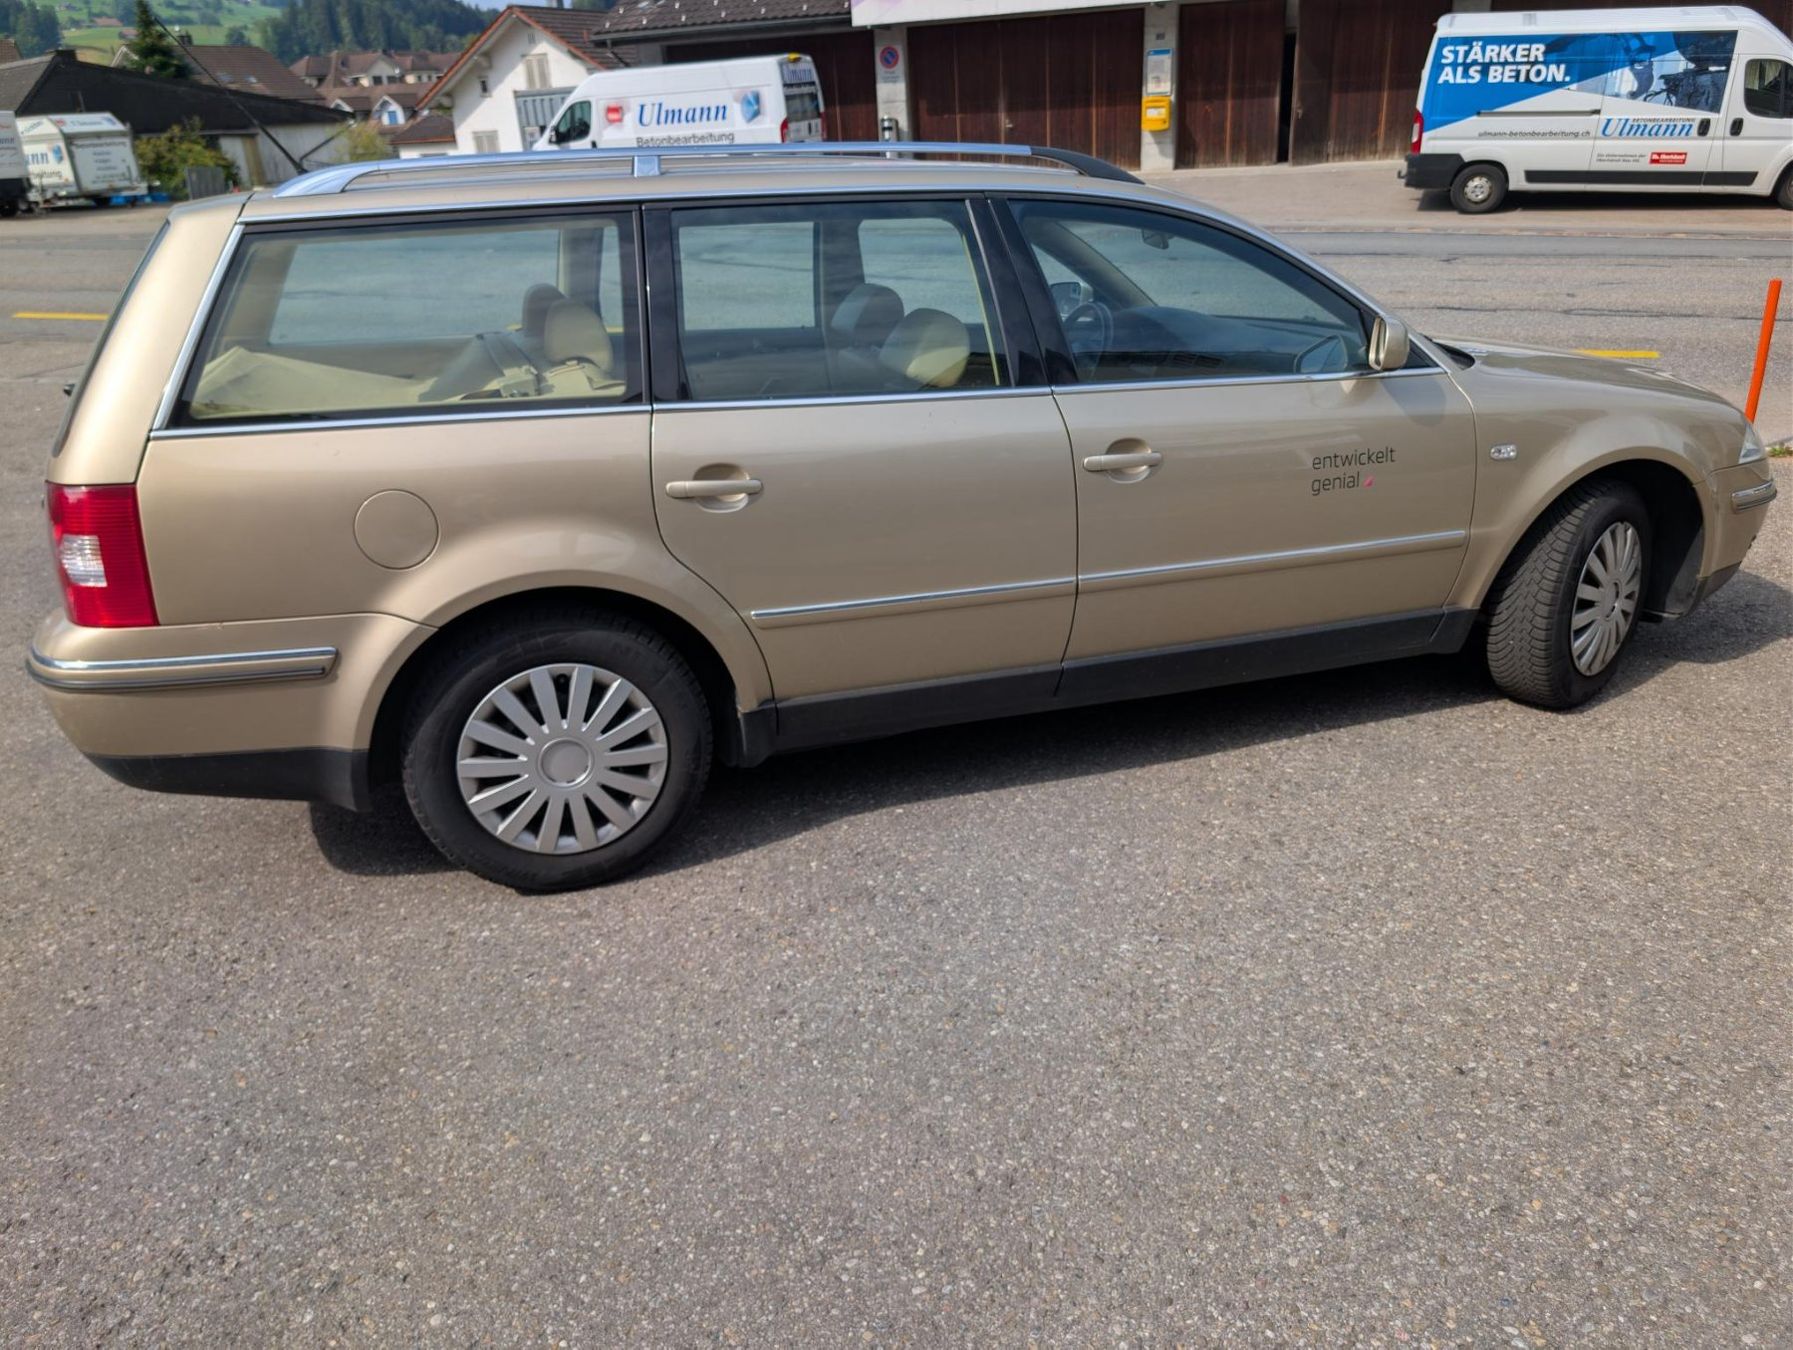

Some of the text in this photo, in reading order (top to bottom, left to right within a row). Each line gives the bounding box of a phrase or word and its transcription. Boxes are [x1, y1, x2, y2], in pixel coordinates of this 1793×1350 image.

[1441, 41, 1546, 64] STÄRKER
[1437, 64, 1571, 84] ALS BETON.
[639, 102, 727, 127] Ulmann
[1478, 129, 1591, 138] ulmann-betonbearbeitung.ch
[1601, 117, 1693, 137] Ulmann
[636, 132, 735, 145] Betonbearbeitung
[1312, 446, 1396, 470] entwickelt
[1311, 471, 1360, 496] genial
